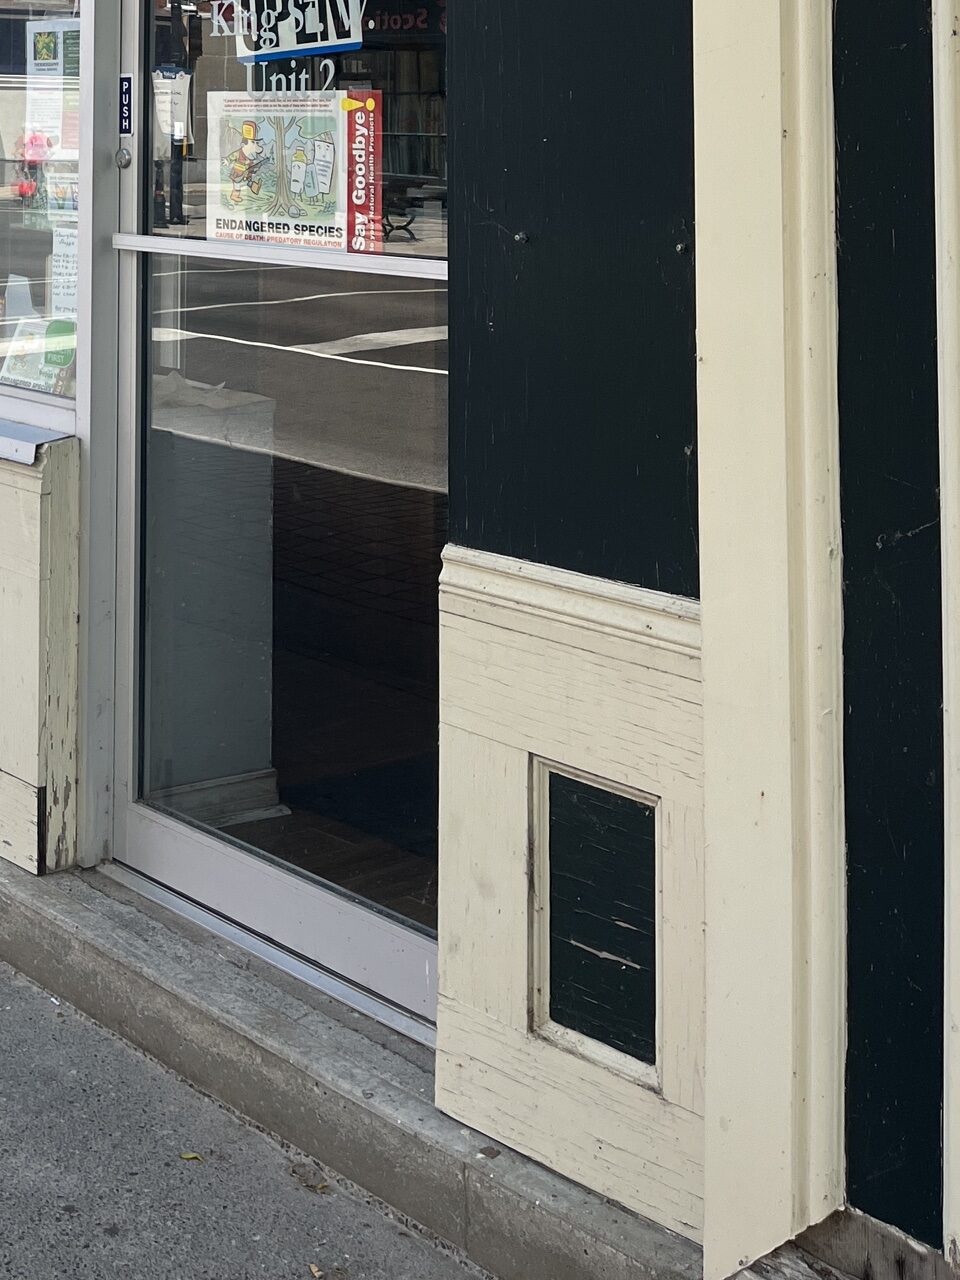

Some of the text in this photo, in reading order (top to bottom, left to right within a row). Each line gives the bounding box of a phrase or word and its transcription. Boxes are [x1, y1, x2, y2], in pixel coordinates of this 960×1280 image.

[209, 0, 278, 49] King
[243, 58, 337, 100] Unit 2
[216, 218, 344, 238] ENDANGERED SPECIES
[244, 233, 266, 242] DEATH:
[266, 236, 302, 244] PREDATORY
[303, 238, 342, 248] REGULATION
[352, 212, 368, 251] Say
